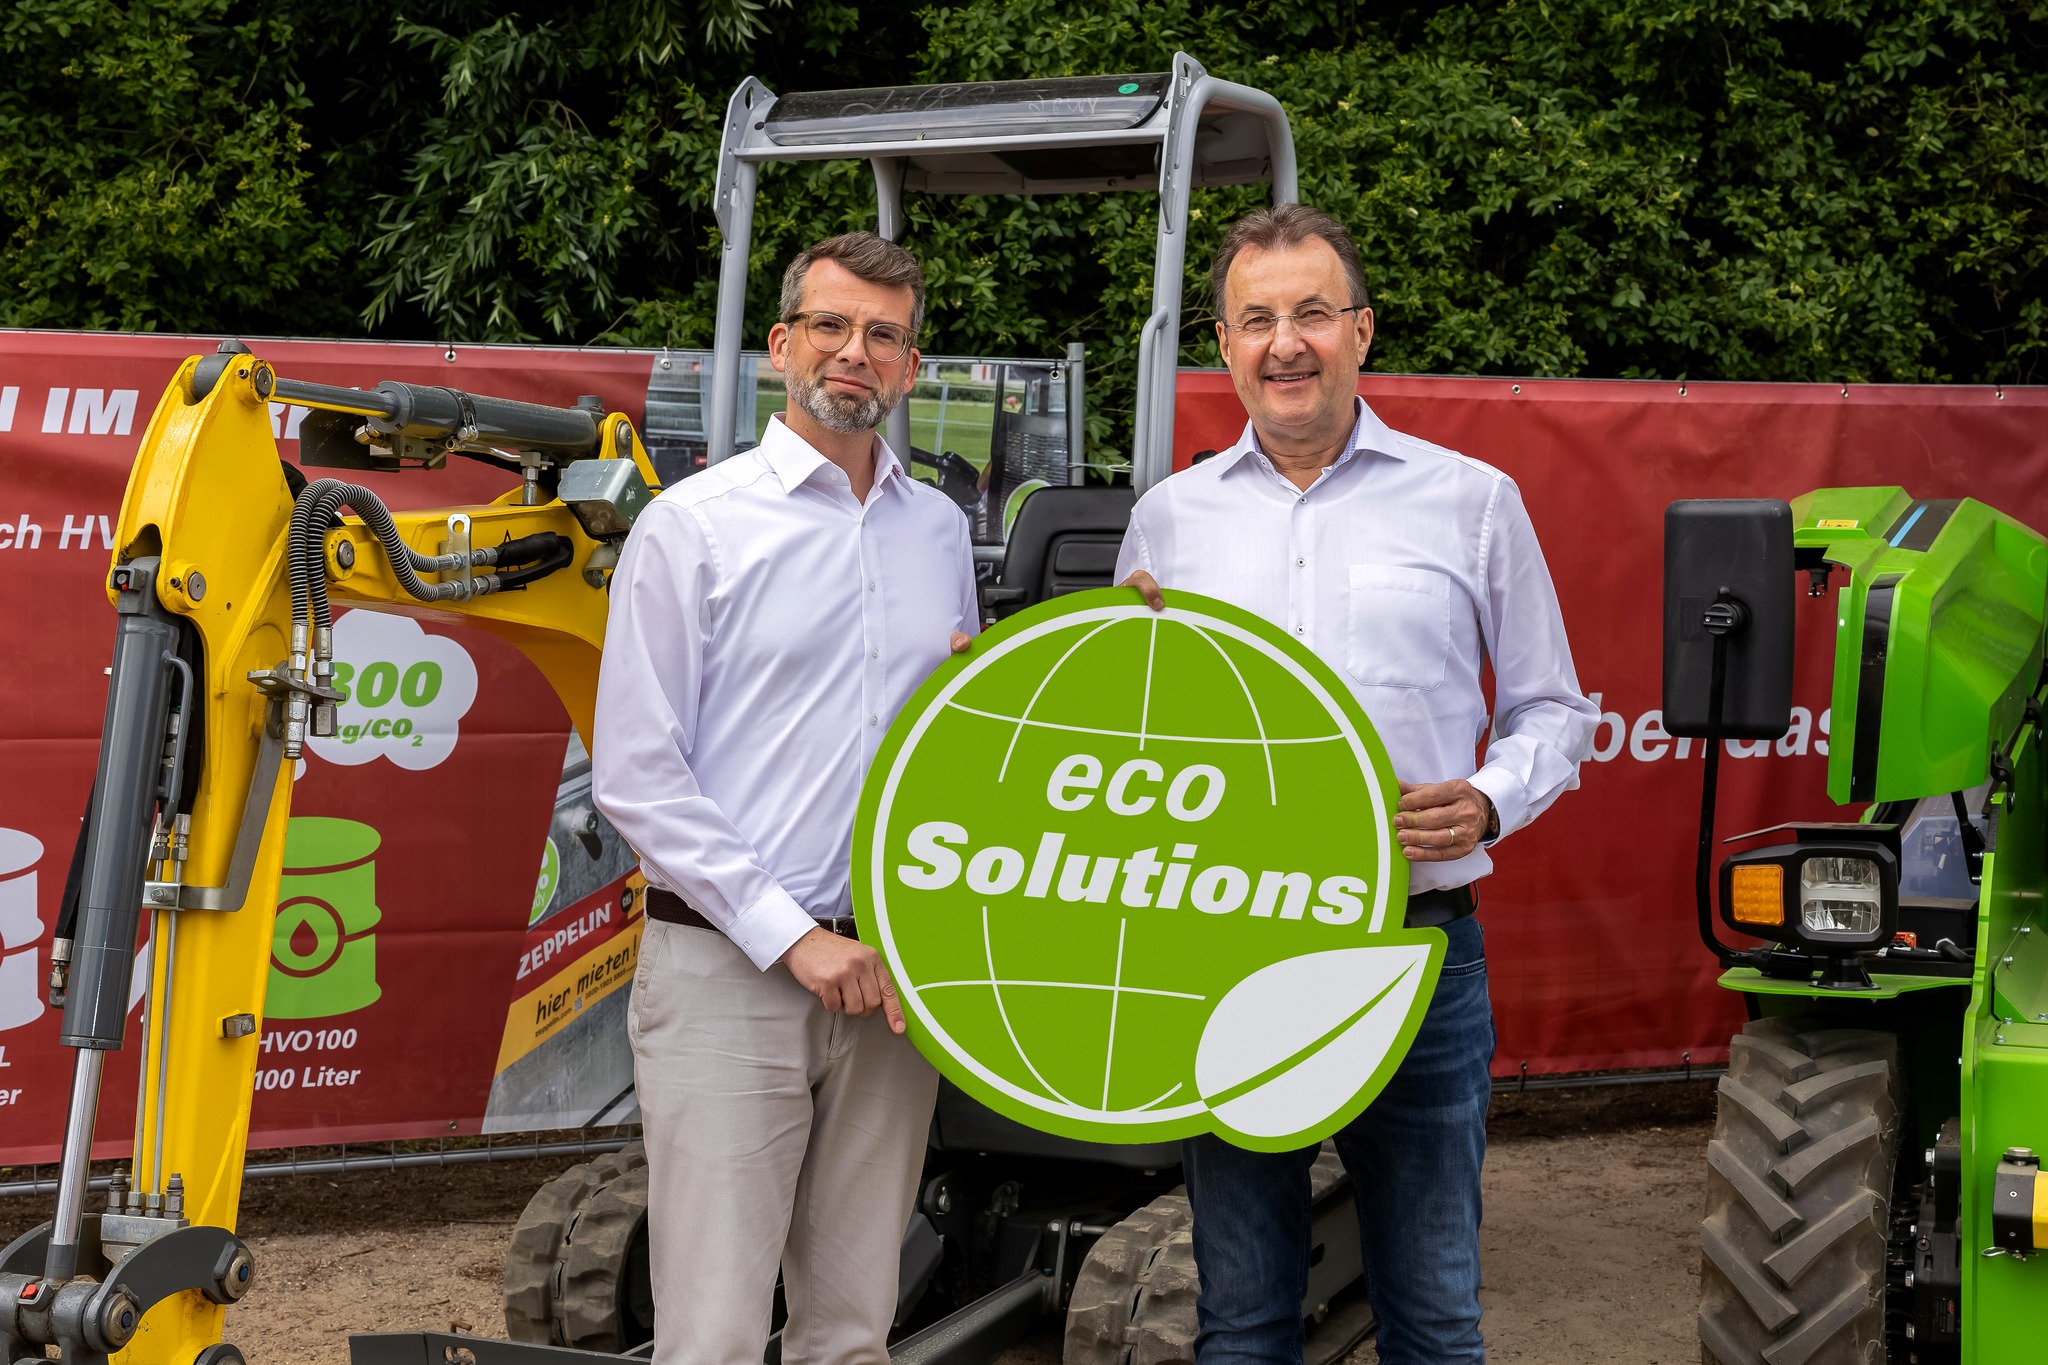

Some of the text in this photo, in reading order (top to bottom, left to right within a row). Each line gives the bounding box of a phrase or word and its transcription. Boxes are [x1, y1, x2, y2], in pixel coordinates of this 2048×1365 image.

[41, 387, 139, 435] IM
[1046, 754, 1227, 822] eco
[897, 821, 1369, 926] Solutions
[516, 903, 611, 981] ZEPPELIN
[535, 986, 571, 1025] hier
[254, 1066, 361, 1091] 100 Liter
